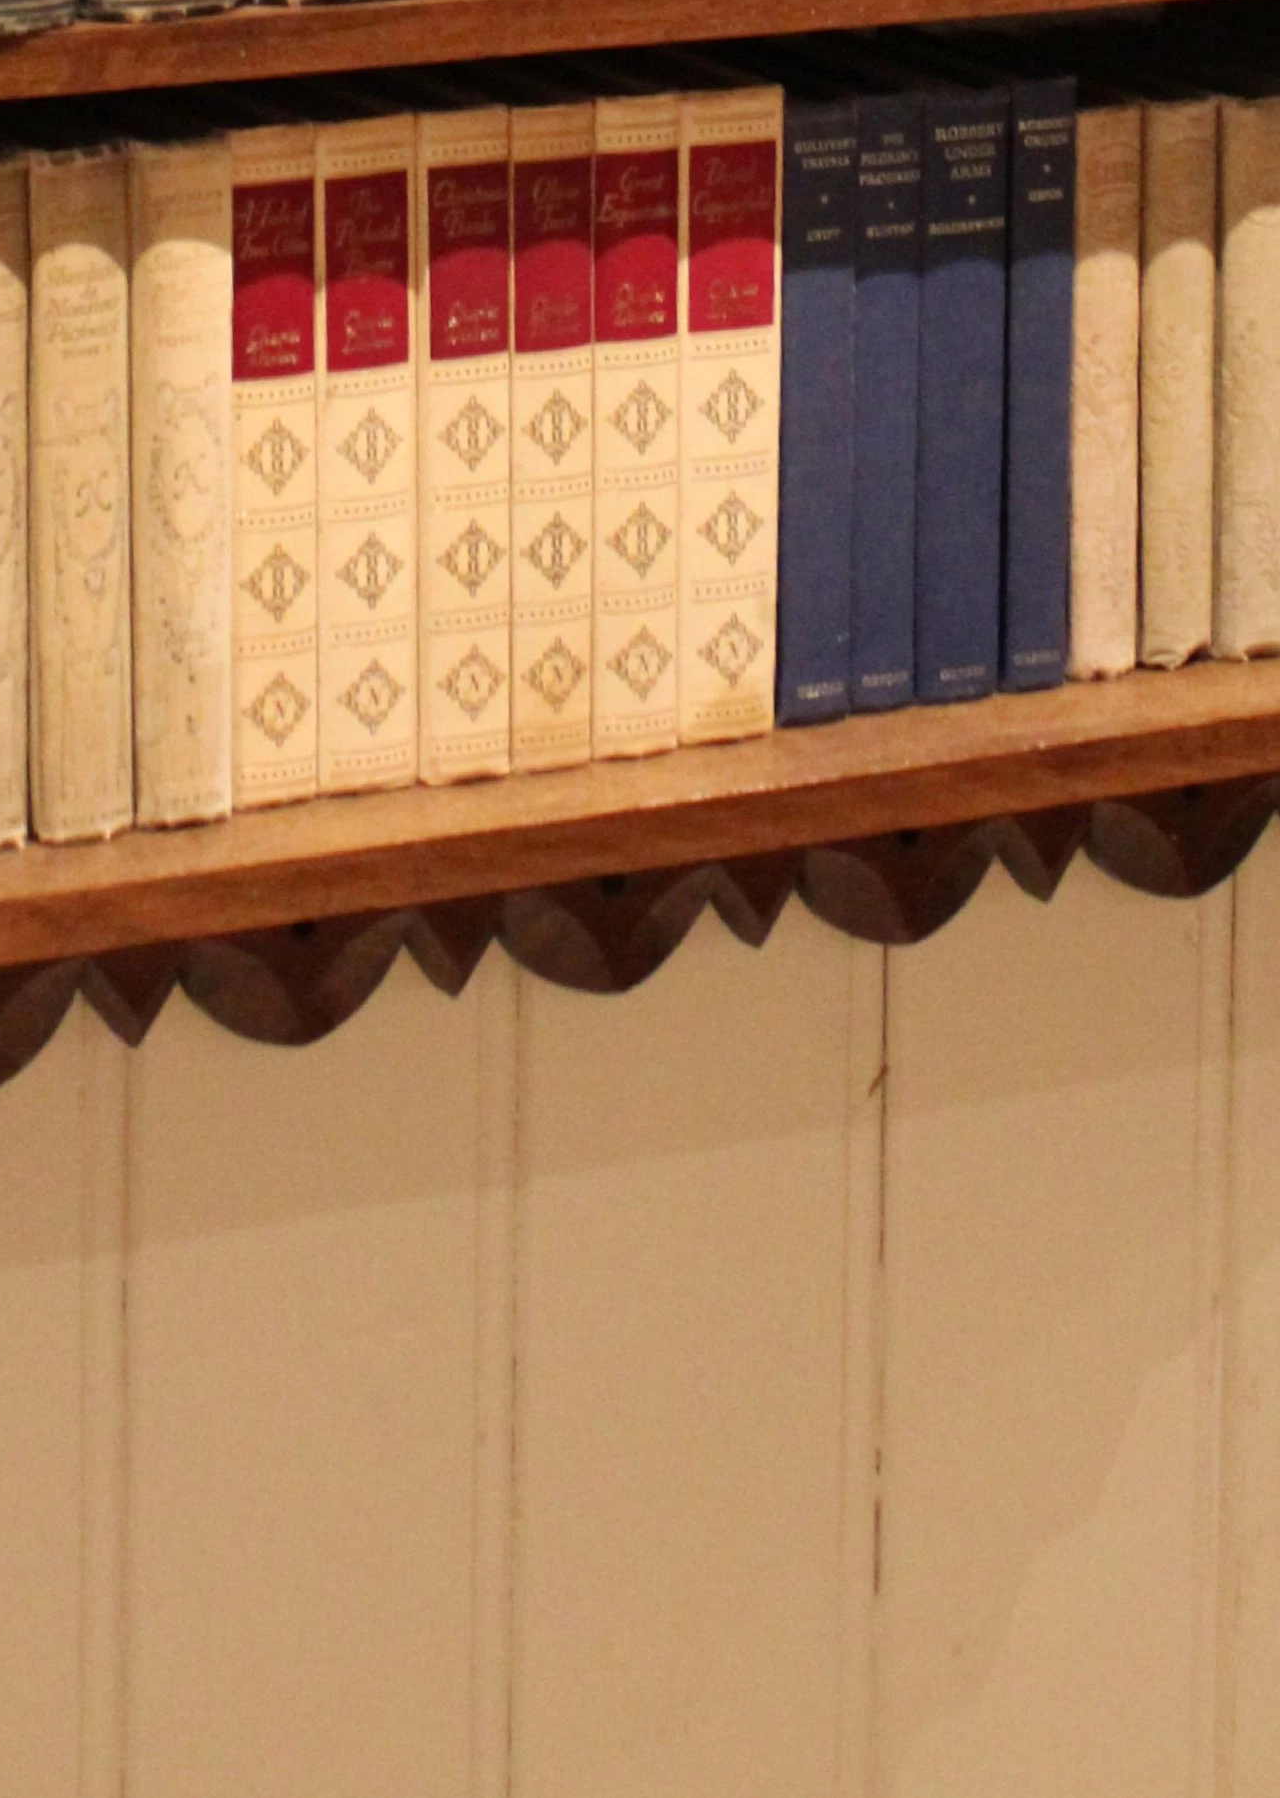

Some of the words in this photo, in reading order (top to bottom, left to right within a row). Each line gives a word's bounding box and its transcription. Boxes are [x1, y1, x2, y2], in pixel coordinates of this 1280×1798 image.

[933, 121, 1005, 143] ROBBERY
[943, 142, 997, 163] UNDER
[949, 162, 993, 182] ARMS
